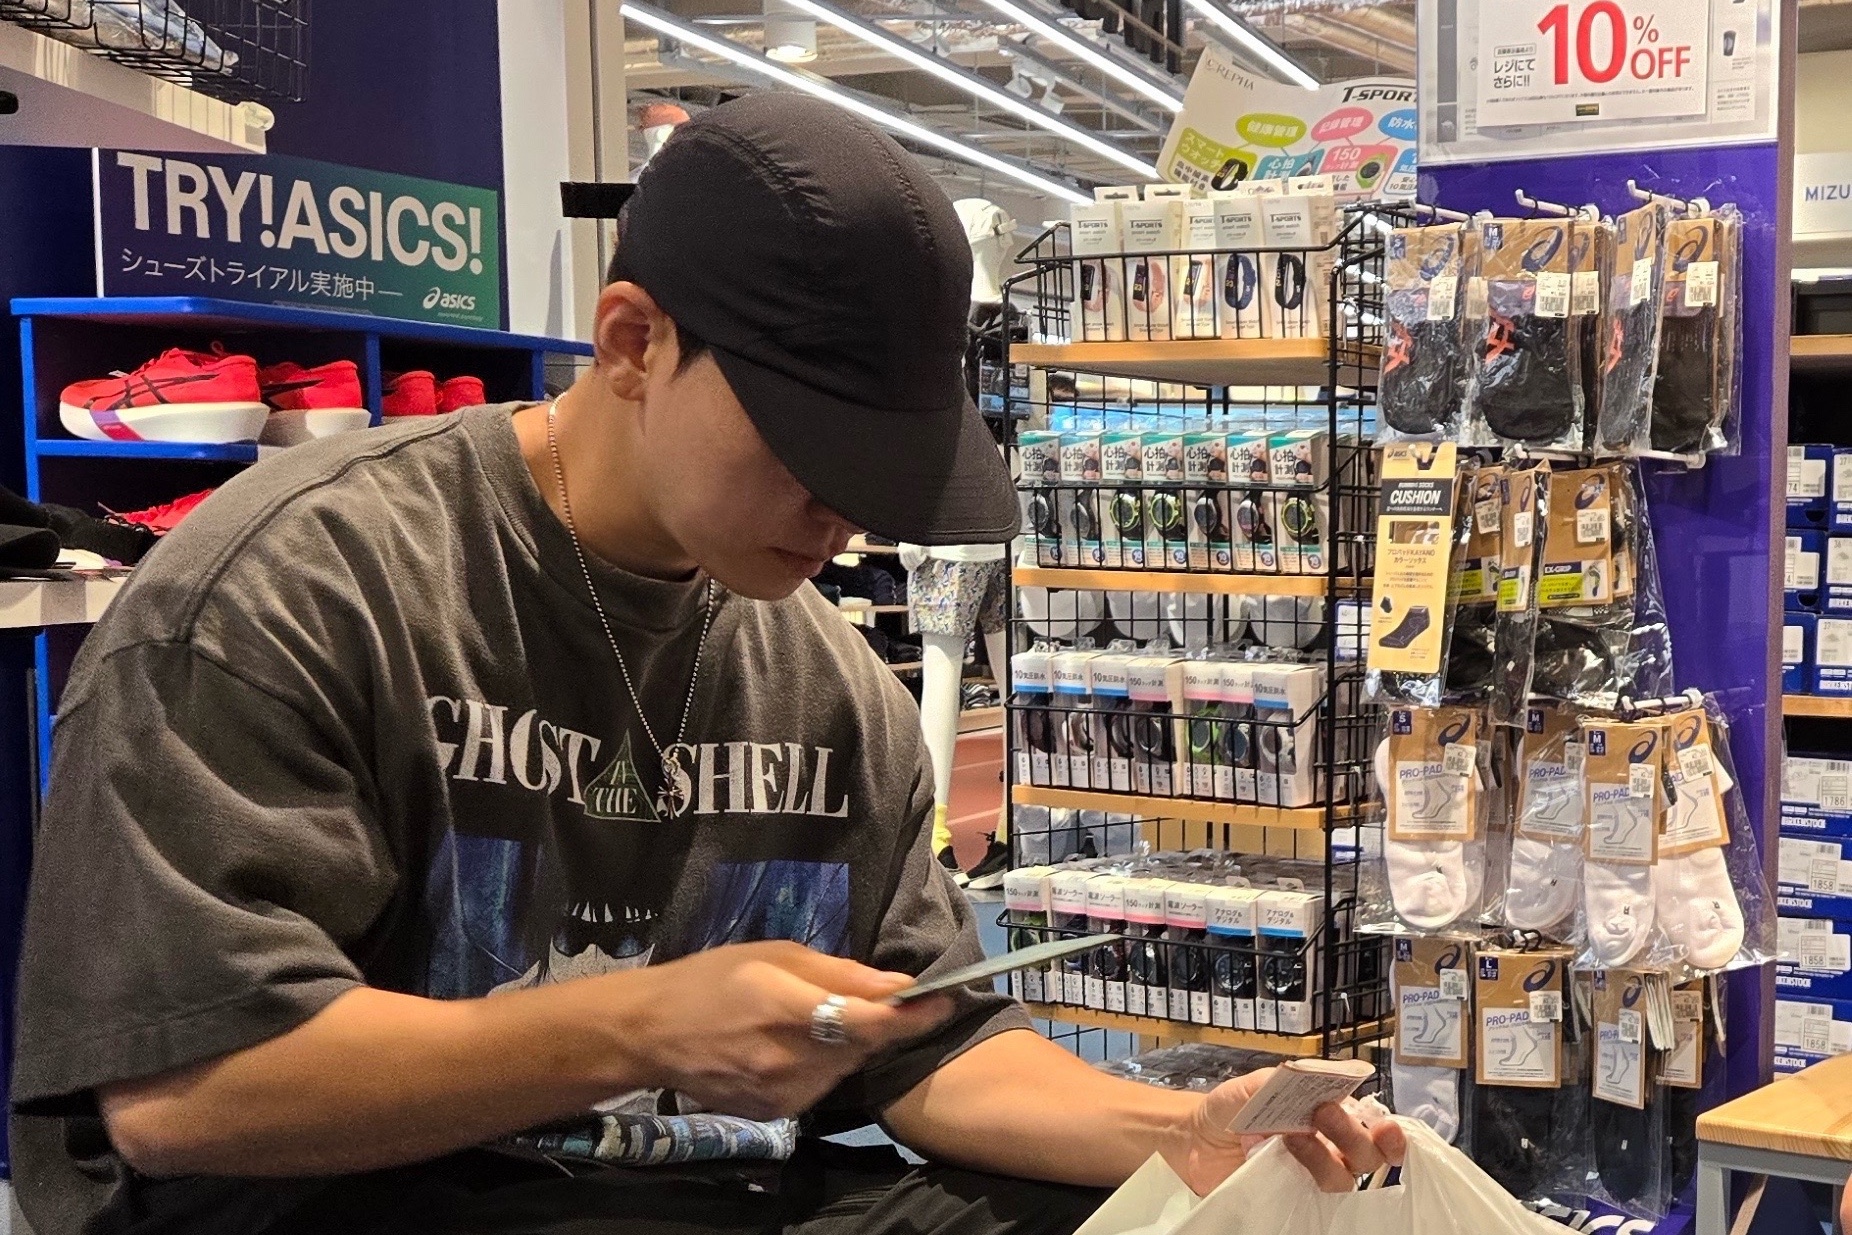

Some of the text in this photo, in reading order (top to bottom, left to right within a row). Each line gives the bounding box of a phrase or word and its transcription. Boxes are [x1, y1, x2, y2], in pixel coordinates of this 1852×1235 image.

[1537, 0, 1627, 85] 10
[1630, 46, 1691, 80] OFF
[1494, 58, 1536, 74] レジにて
[1387, 116, 1417, 130] 防水
[1335, 148, 1362, 161] 150
[1805, 184, 1851, 201] MIZU
[117, 152, 482, 275] TRY!ASICS!
[1220, 213, 1252, 224] T-SPORTS
[1270, 212, 1302, 223] T-SPORTS
[1077, 219, 1108, 228] T-SPORTS
[1130, 220, 1162, 228] T-SPORTS
[440, 293, 477, 310] asics
[1022, 447, 1042, 460] 心拍
[1063, 447, 1082, 460] 心拍
[1104, 446, 1124, 460] 心拍
[1144, 446, 1164, 460] 心拍
[1186, 446, 1207, 460] 心拍
[1230, 447, 1250, 460] 心拍
[1273, 448, 1293, 462] 心拍
[1390, 489, 1442, 505] CUSHION
[1223, 678, 1253, 688] 150ラップ計
[1531, 713, 1540, 722] M
[1593, 734, 1602, 744] M
[428, 695, 602, 805] GHOST
[1400, 763, 1443, 779] PRO-PAD
[658, 740, 849, 819] SHELL
[592, 787, 638, 814] THE
[1813, 880, 1834, 891] 1858
[1400, 942, 1408, 951] M
[1803, 956, 1824, 965] 1858
[1403, 990, 1440, 1004] PRO-PAD
[1486, 1011, 1530, 1026] PRO-PAD
[1806, 1038, 1826, 1050] 1858
